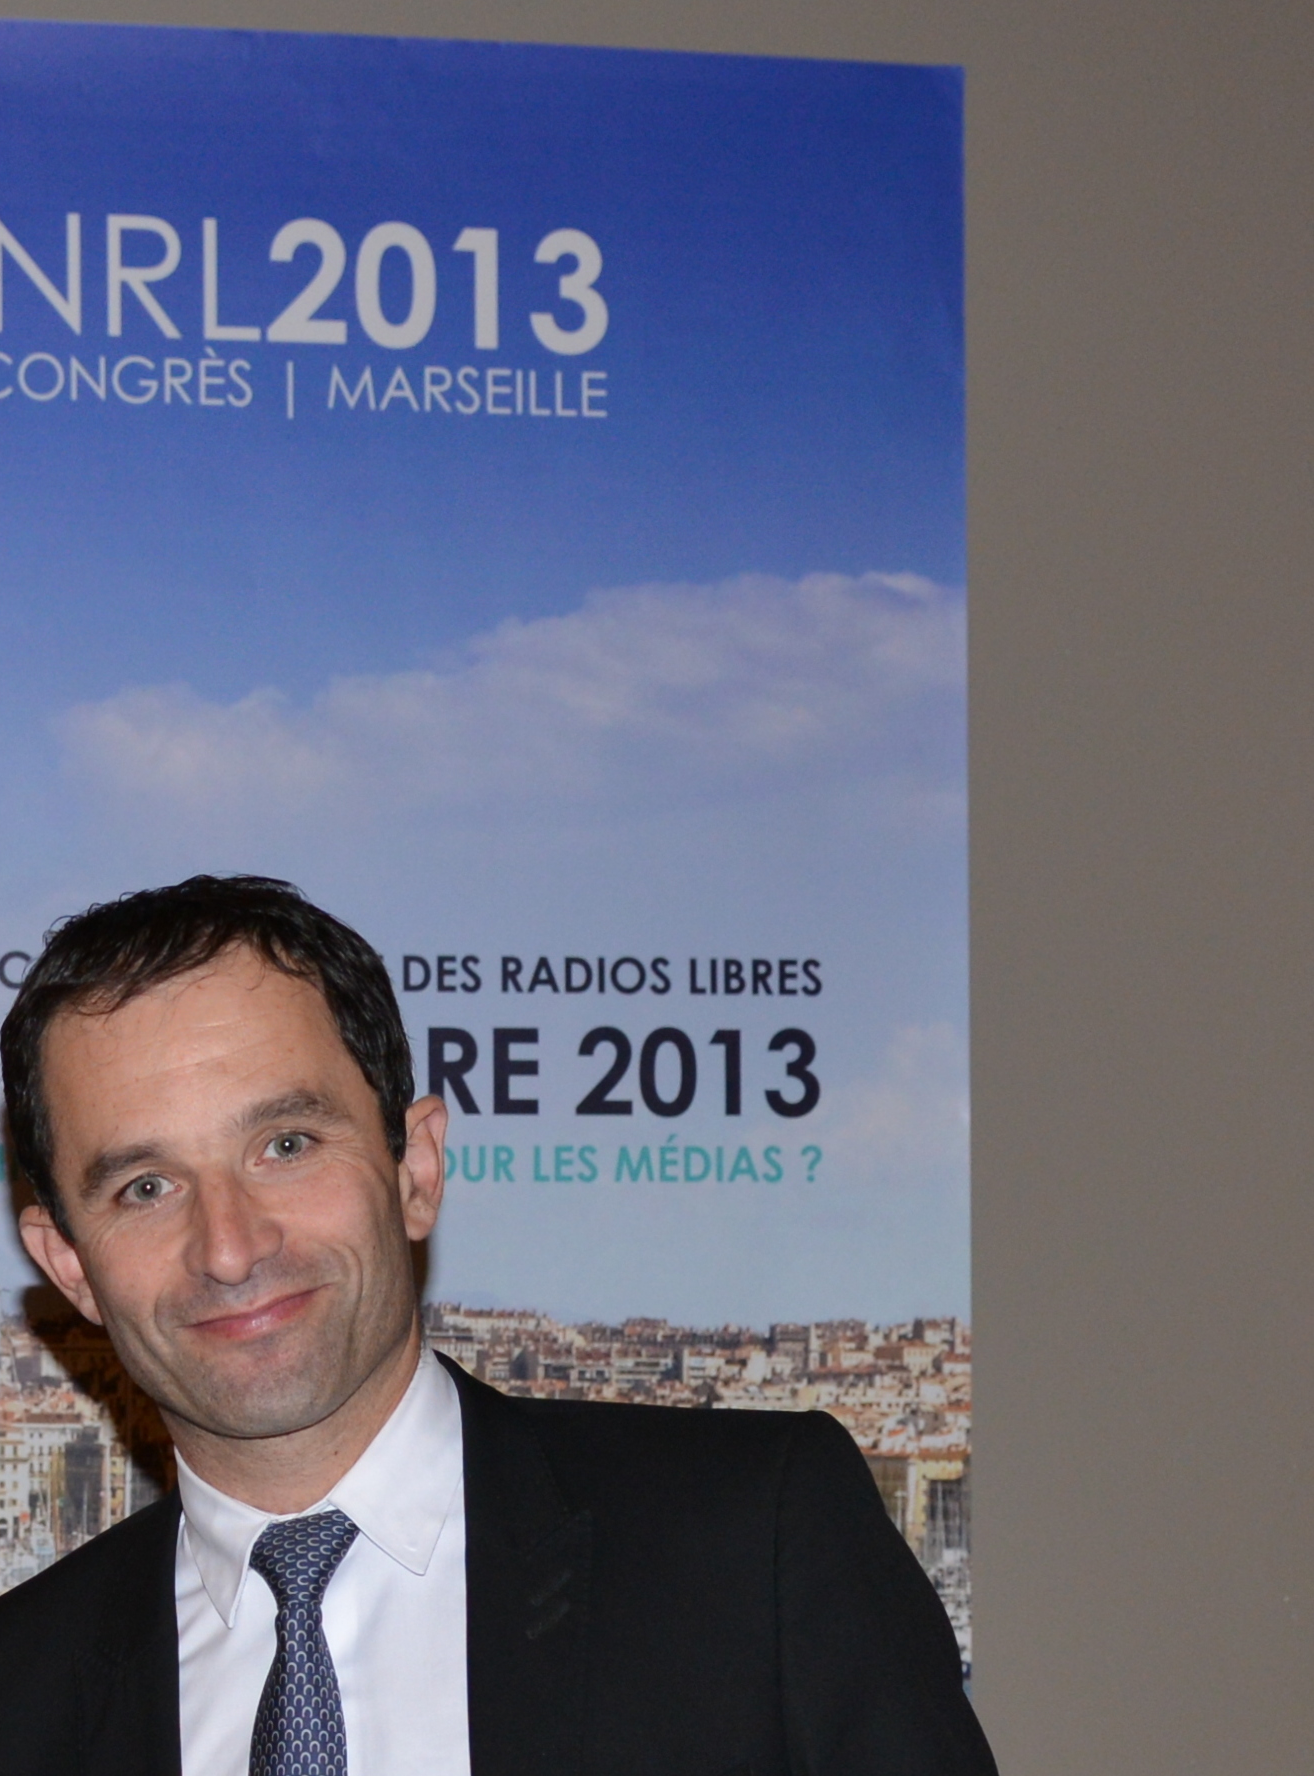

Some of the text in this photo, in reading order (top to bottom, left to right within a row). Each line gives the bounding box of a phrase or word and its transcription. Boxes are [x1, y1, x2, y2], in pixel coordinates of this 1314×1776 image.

[327, 364, 609, 418] MARSEILLE
[402, 955, 482, 994] DES
[501, 955, 672, 996] RADIOS
[689, 957, 823, 997] LIBRES
[427, 1026, 540, 1116] RE
[575, 1026, 822, 1119] 2013
[532, 1144, 599, 1184] LES
[614, 1133, 784, 1184] MÉDIAS
[800, 1144, 823, 1184] ?
